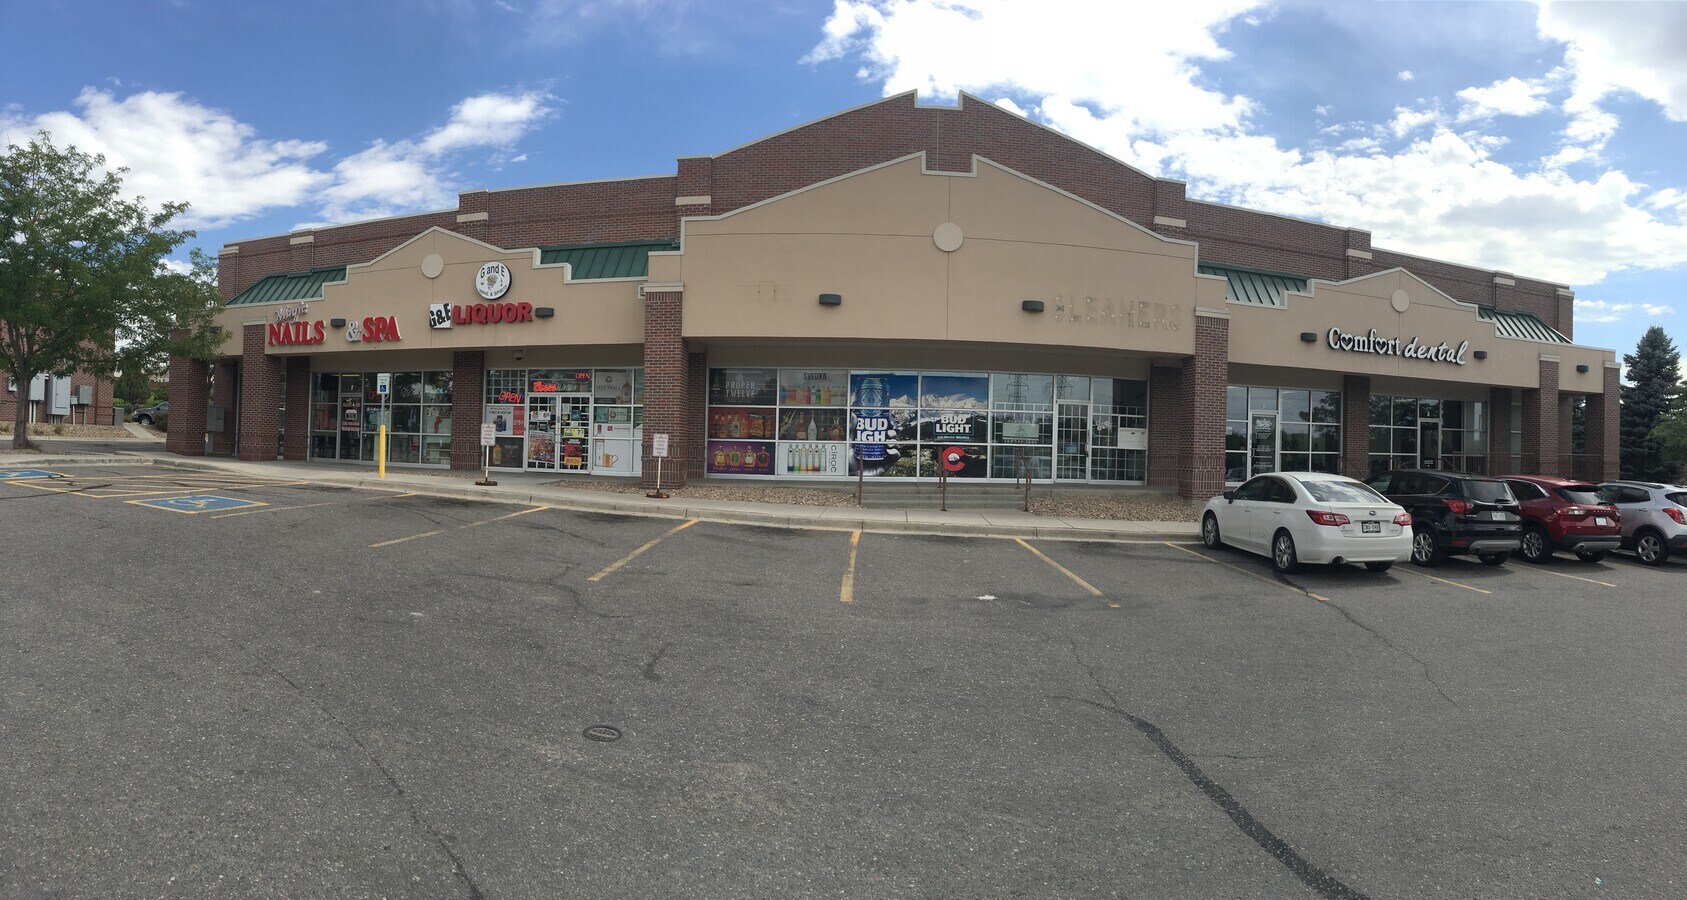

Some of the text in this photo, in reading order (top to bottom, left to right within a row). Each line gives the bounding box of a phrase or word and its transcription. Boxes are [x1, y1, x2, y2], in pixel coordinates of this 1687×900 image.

[480, 263, 506, 279] G and E
[430, 302, 533, 327] G&E LIQUOR
[268, 316, 402, 346] NAILS & SPA
[1327, 327, 1469, 365] Comfort dental
[575, 372, 590, 380] OPEN
[725, 380, 756, 389] PROPER
[498, 390, 523, 403] OPEN
[725, 389, 756, 398] TWELVE
[856, 417, 888, 431] BUD
[941, 413, 971, 424] BUD
[935, 423, 972, 433] LIGHT
